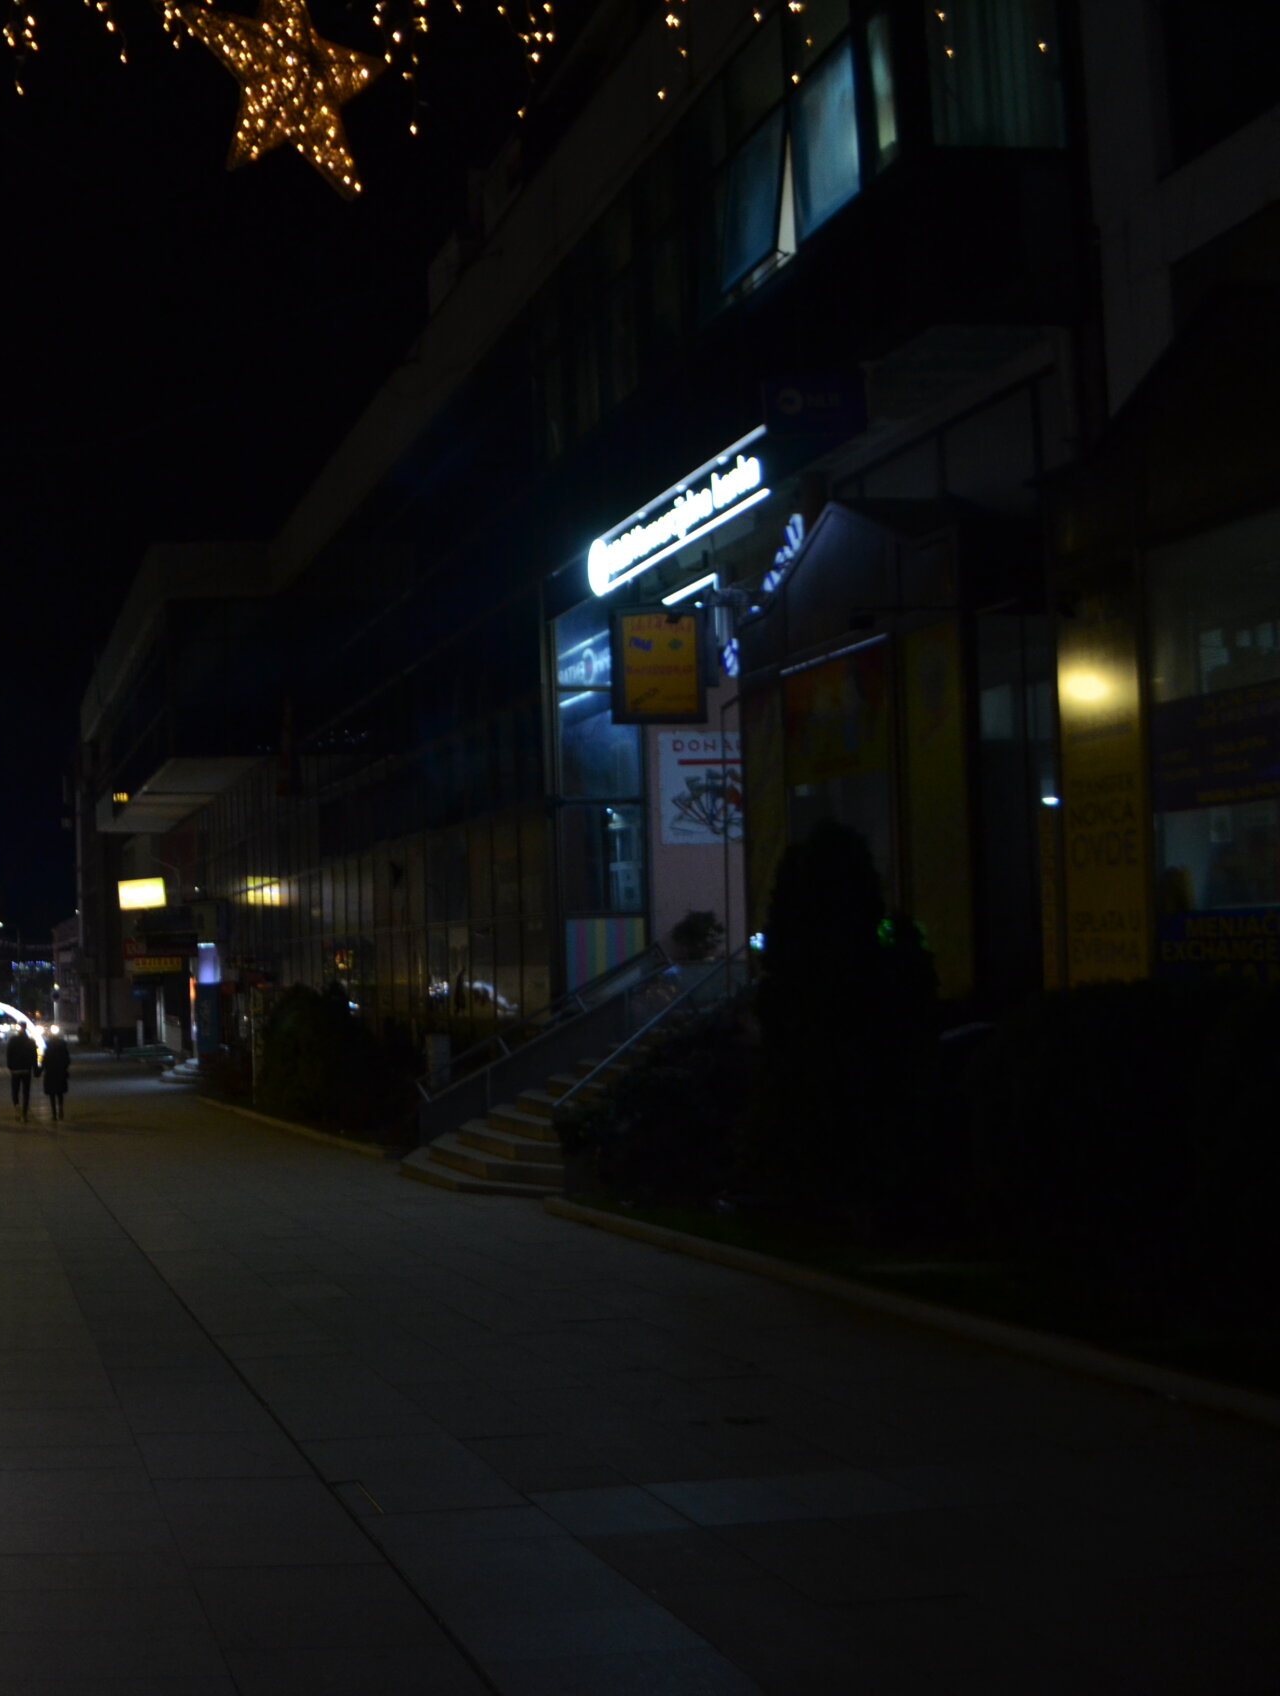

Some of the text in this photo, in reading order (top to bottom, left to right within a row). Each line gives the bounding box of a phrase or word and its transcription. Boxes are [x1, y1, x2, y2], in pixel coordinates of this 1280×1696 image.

[672, 739, 742, 753] DONA
[1185, 909, 1280, 938] MENJAČ
[1161, 937, 1279, 963] EXCHANGE
